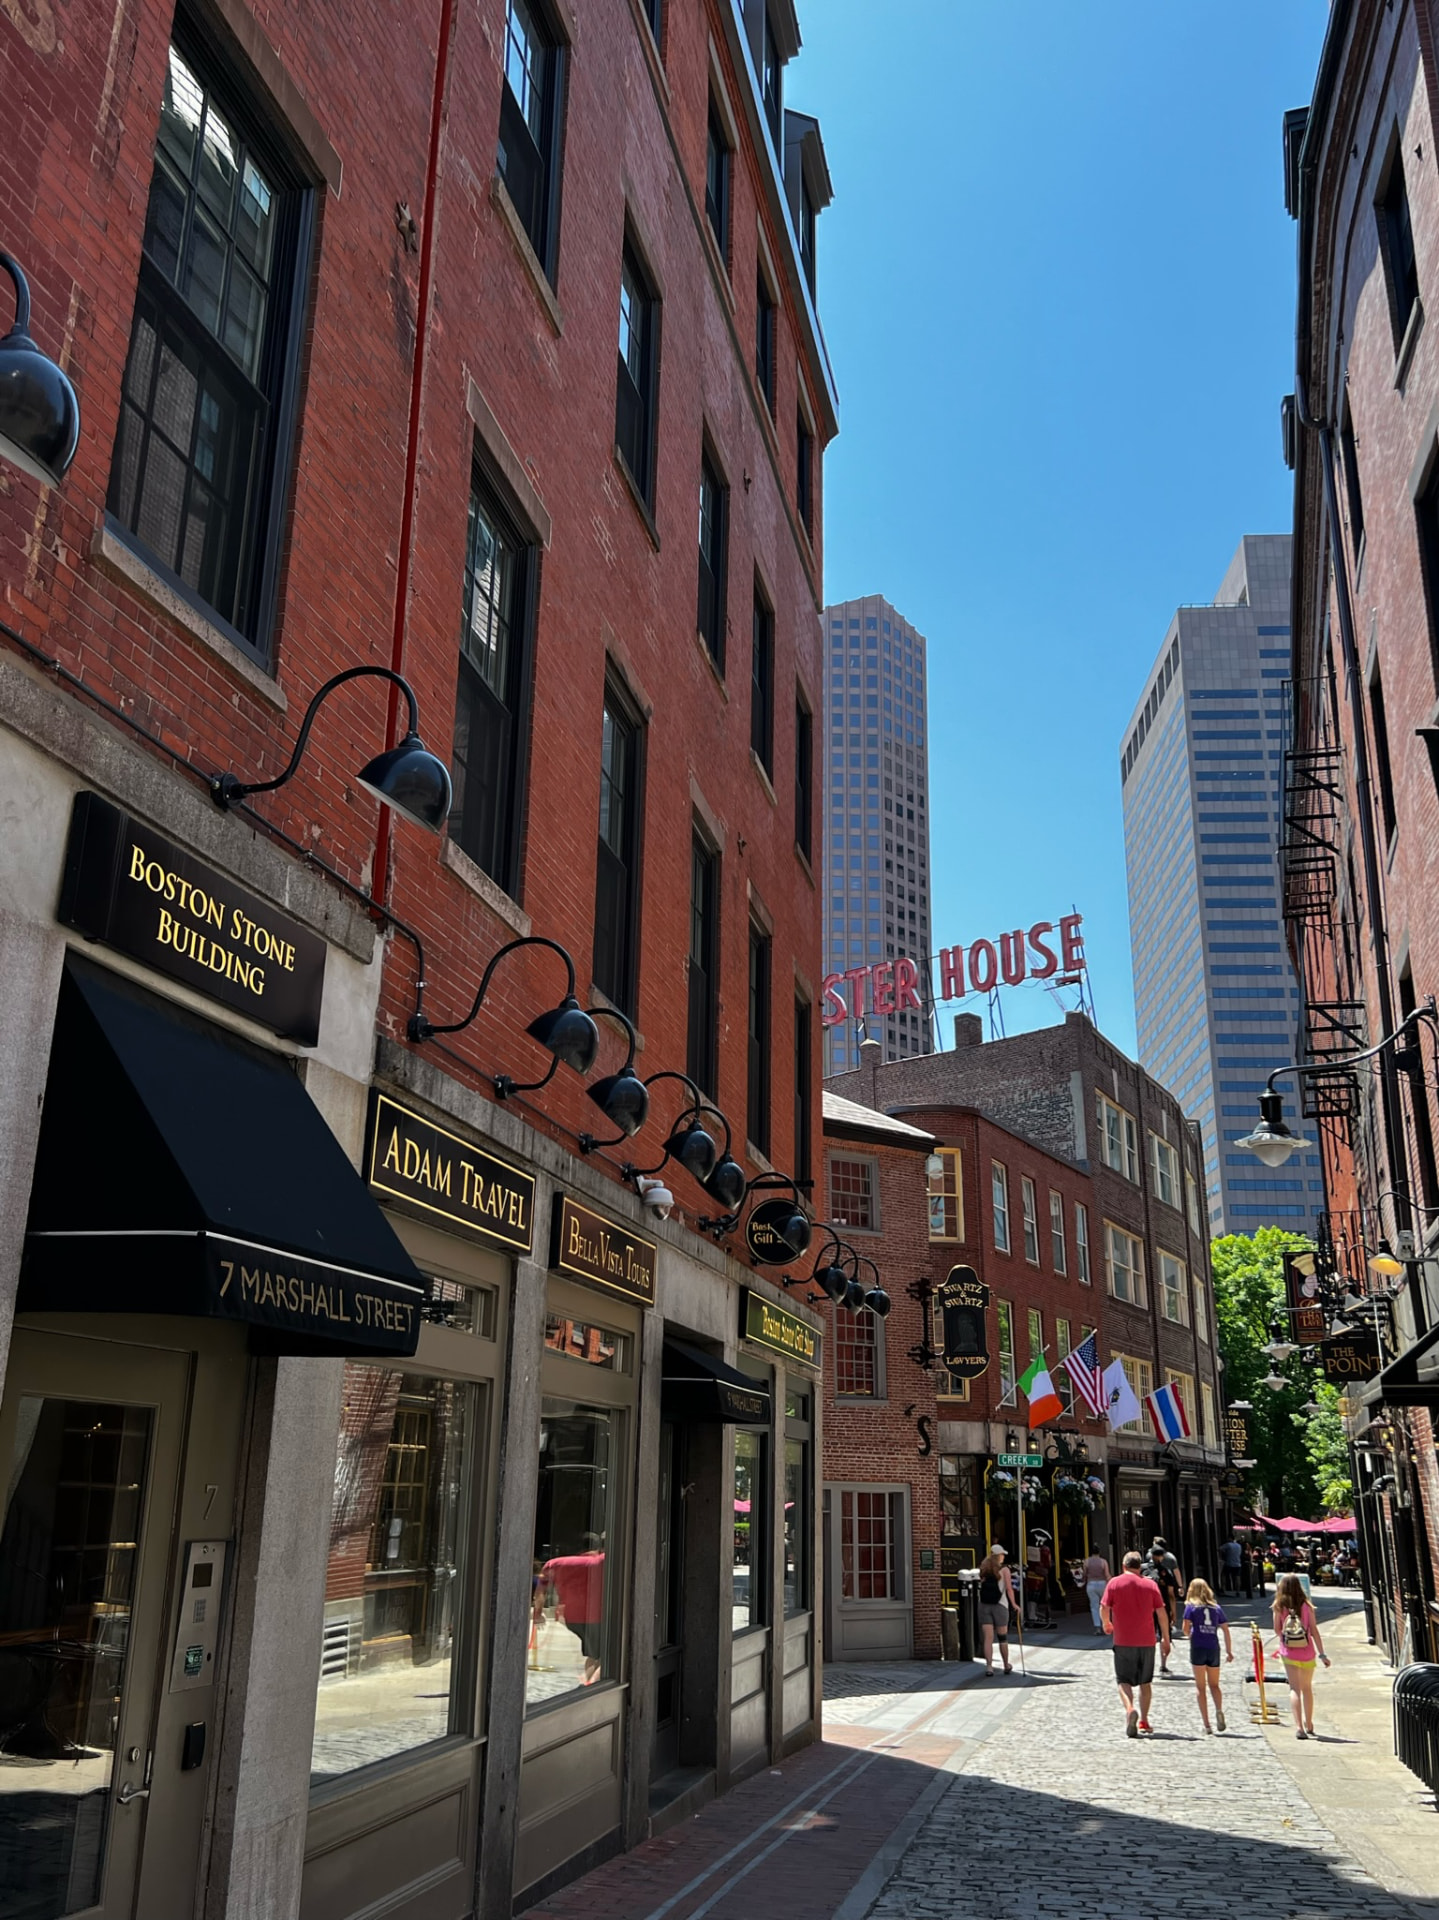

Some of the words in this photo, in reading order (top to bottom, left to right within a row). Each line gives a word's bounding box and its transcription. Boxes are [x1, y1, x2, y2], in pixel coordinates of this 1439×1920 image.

[128, 844, 226, 930] BOSTON
[230, 908, 296, 972] STONE
[156, 907, 265, 995] BUILDING
[822, 957, 922, 1025] STER
[939, 912, 1086, 1000] HOUSE
[382, 1125, 452, 1198] ADAM
[460, 1160, 526, 1230] TRAVEL
[568, 1215, 599, 1266] BELLA
[600, 1231, 624, 1277] VISTA
[626, 1245, 650, 1289] TOURS
[219, 1260, 234, 1297] 7
[241, 1265, 351, 1322] MARSHALL
[355, 1292, 414, 1333] STREET
[943, 1282, 983, 1295] SWARTZ
[944, 1297, 984, 1309] SWARTZ
[946, 1356, 987, 1365] LAWYERS
[1326, 1353, 1382, 1376] POINT
[1331, 1347, 1355, 1357] THE
[1001, 1455, 1028, 1465] CREEK
[204, 1485, 219, 1520] 7
[1203, 1608, 1212, 1626] 1
